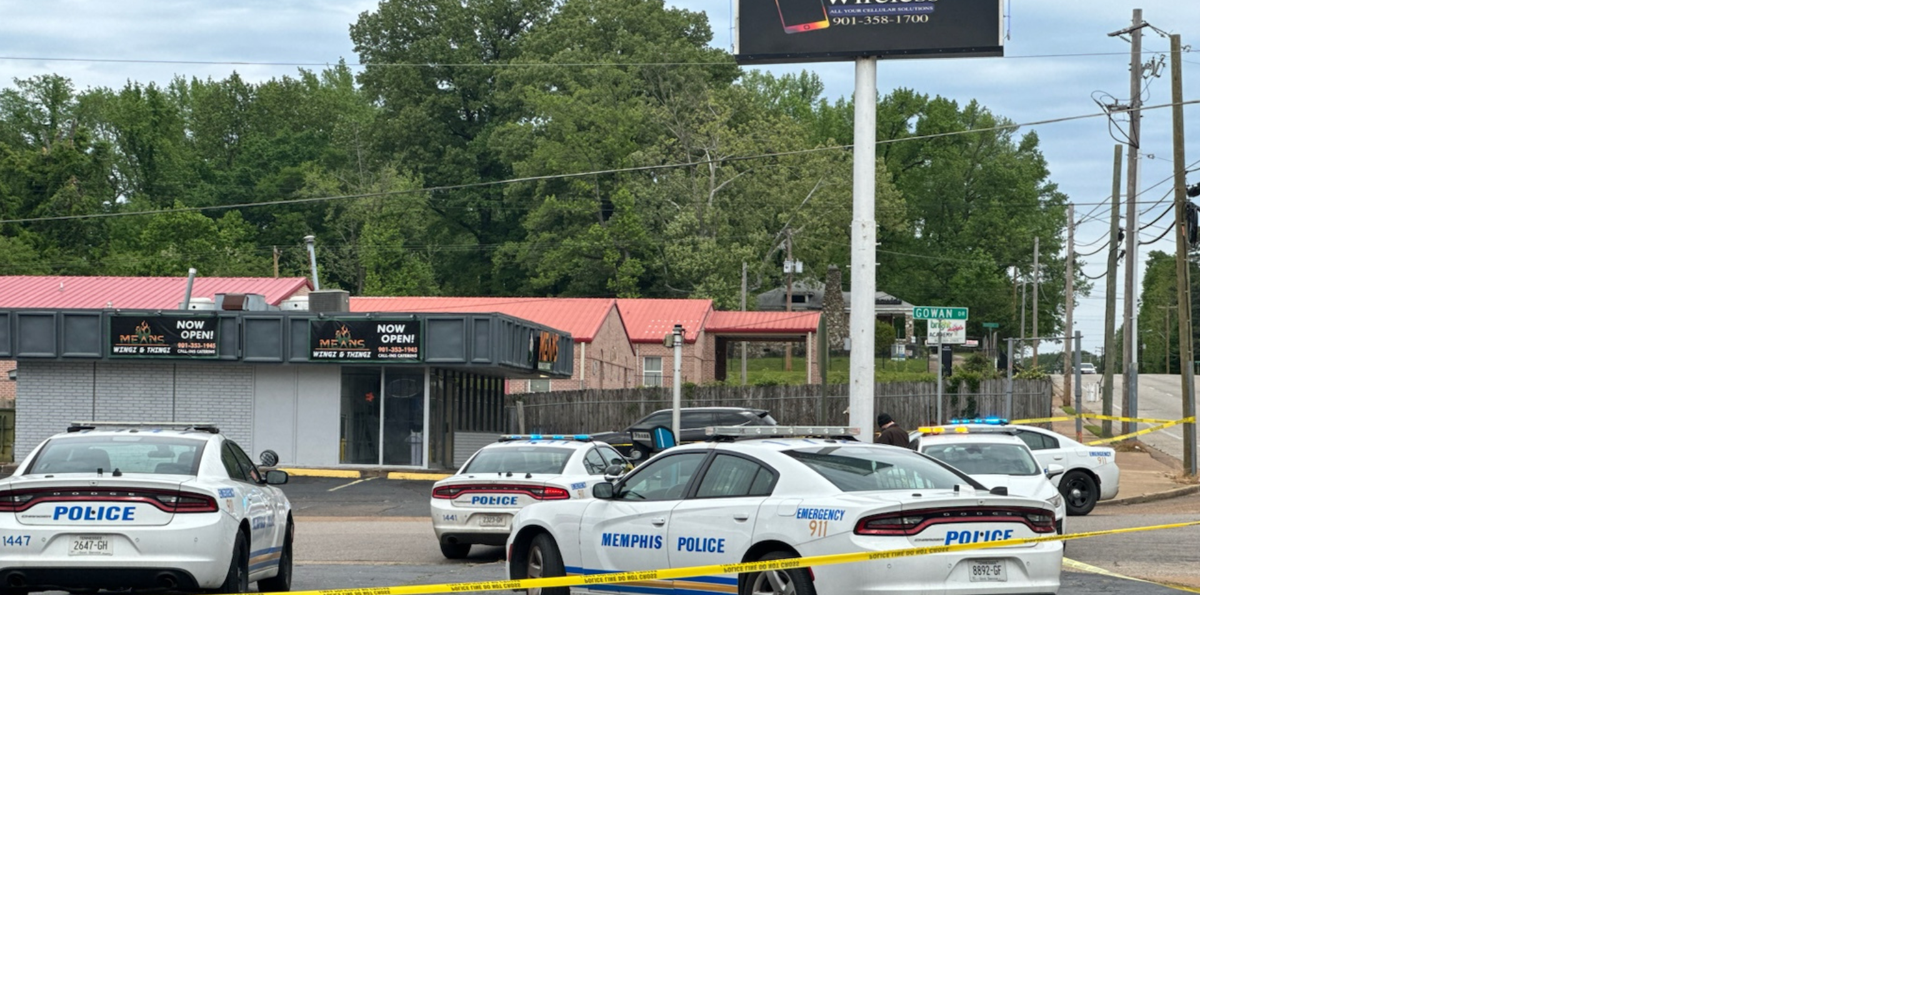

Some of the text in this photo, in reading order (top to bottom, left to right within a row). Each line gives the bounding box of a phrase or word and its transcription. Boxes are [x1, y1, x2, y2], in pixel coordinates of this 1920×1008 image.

[832, 14, 929, 26] 901-358-1700
[915, 308, 953, 318] GOWAN
[176, 320, 205, 330] NOW
[376, 324, 406, 334] NOW
[119, 334, 165, 344] MEANS
[180, 330, 214, 340] OPEN!
[380, 334, 415, 344] OPEN!
[319, 339, 365, 348] MEANS
[471, 495, 519, 506] POLICE
[53, 506, 137, 521] POLICE
[442, 514, 458, 522] 1441
[796, 507, 846, 521] EMERGENCY
[808, 520, 829, 538] 911
[2, 535, 31, 547] 1447
[601, 532, 726, 554] MEMPHIS POLICE
[944, 529, 1014, 546] POLICE
[73, 540, 109, 551] 2647-GH
[972, 564, 1002, 576] 8892-GF
